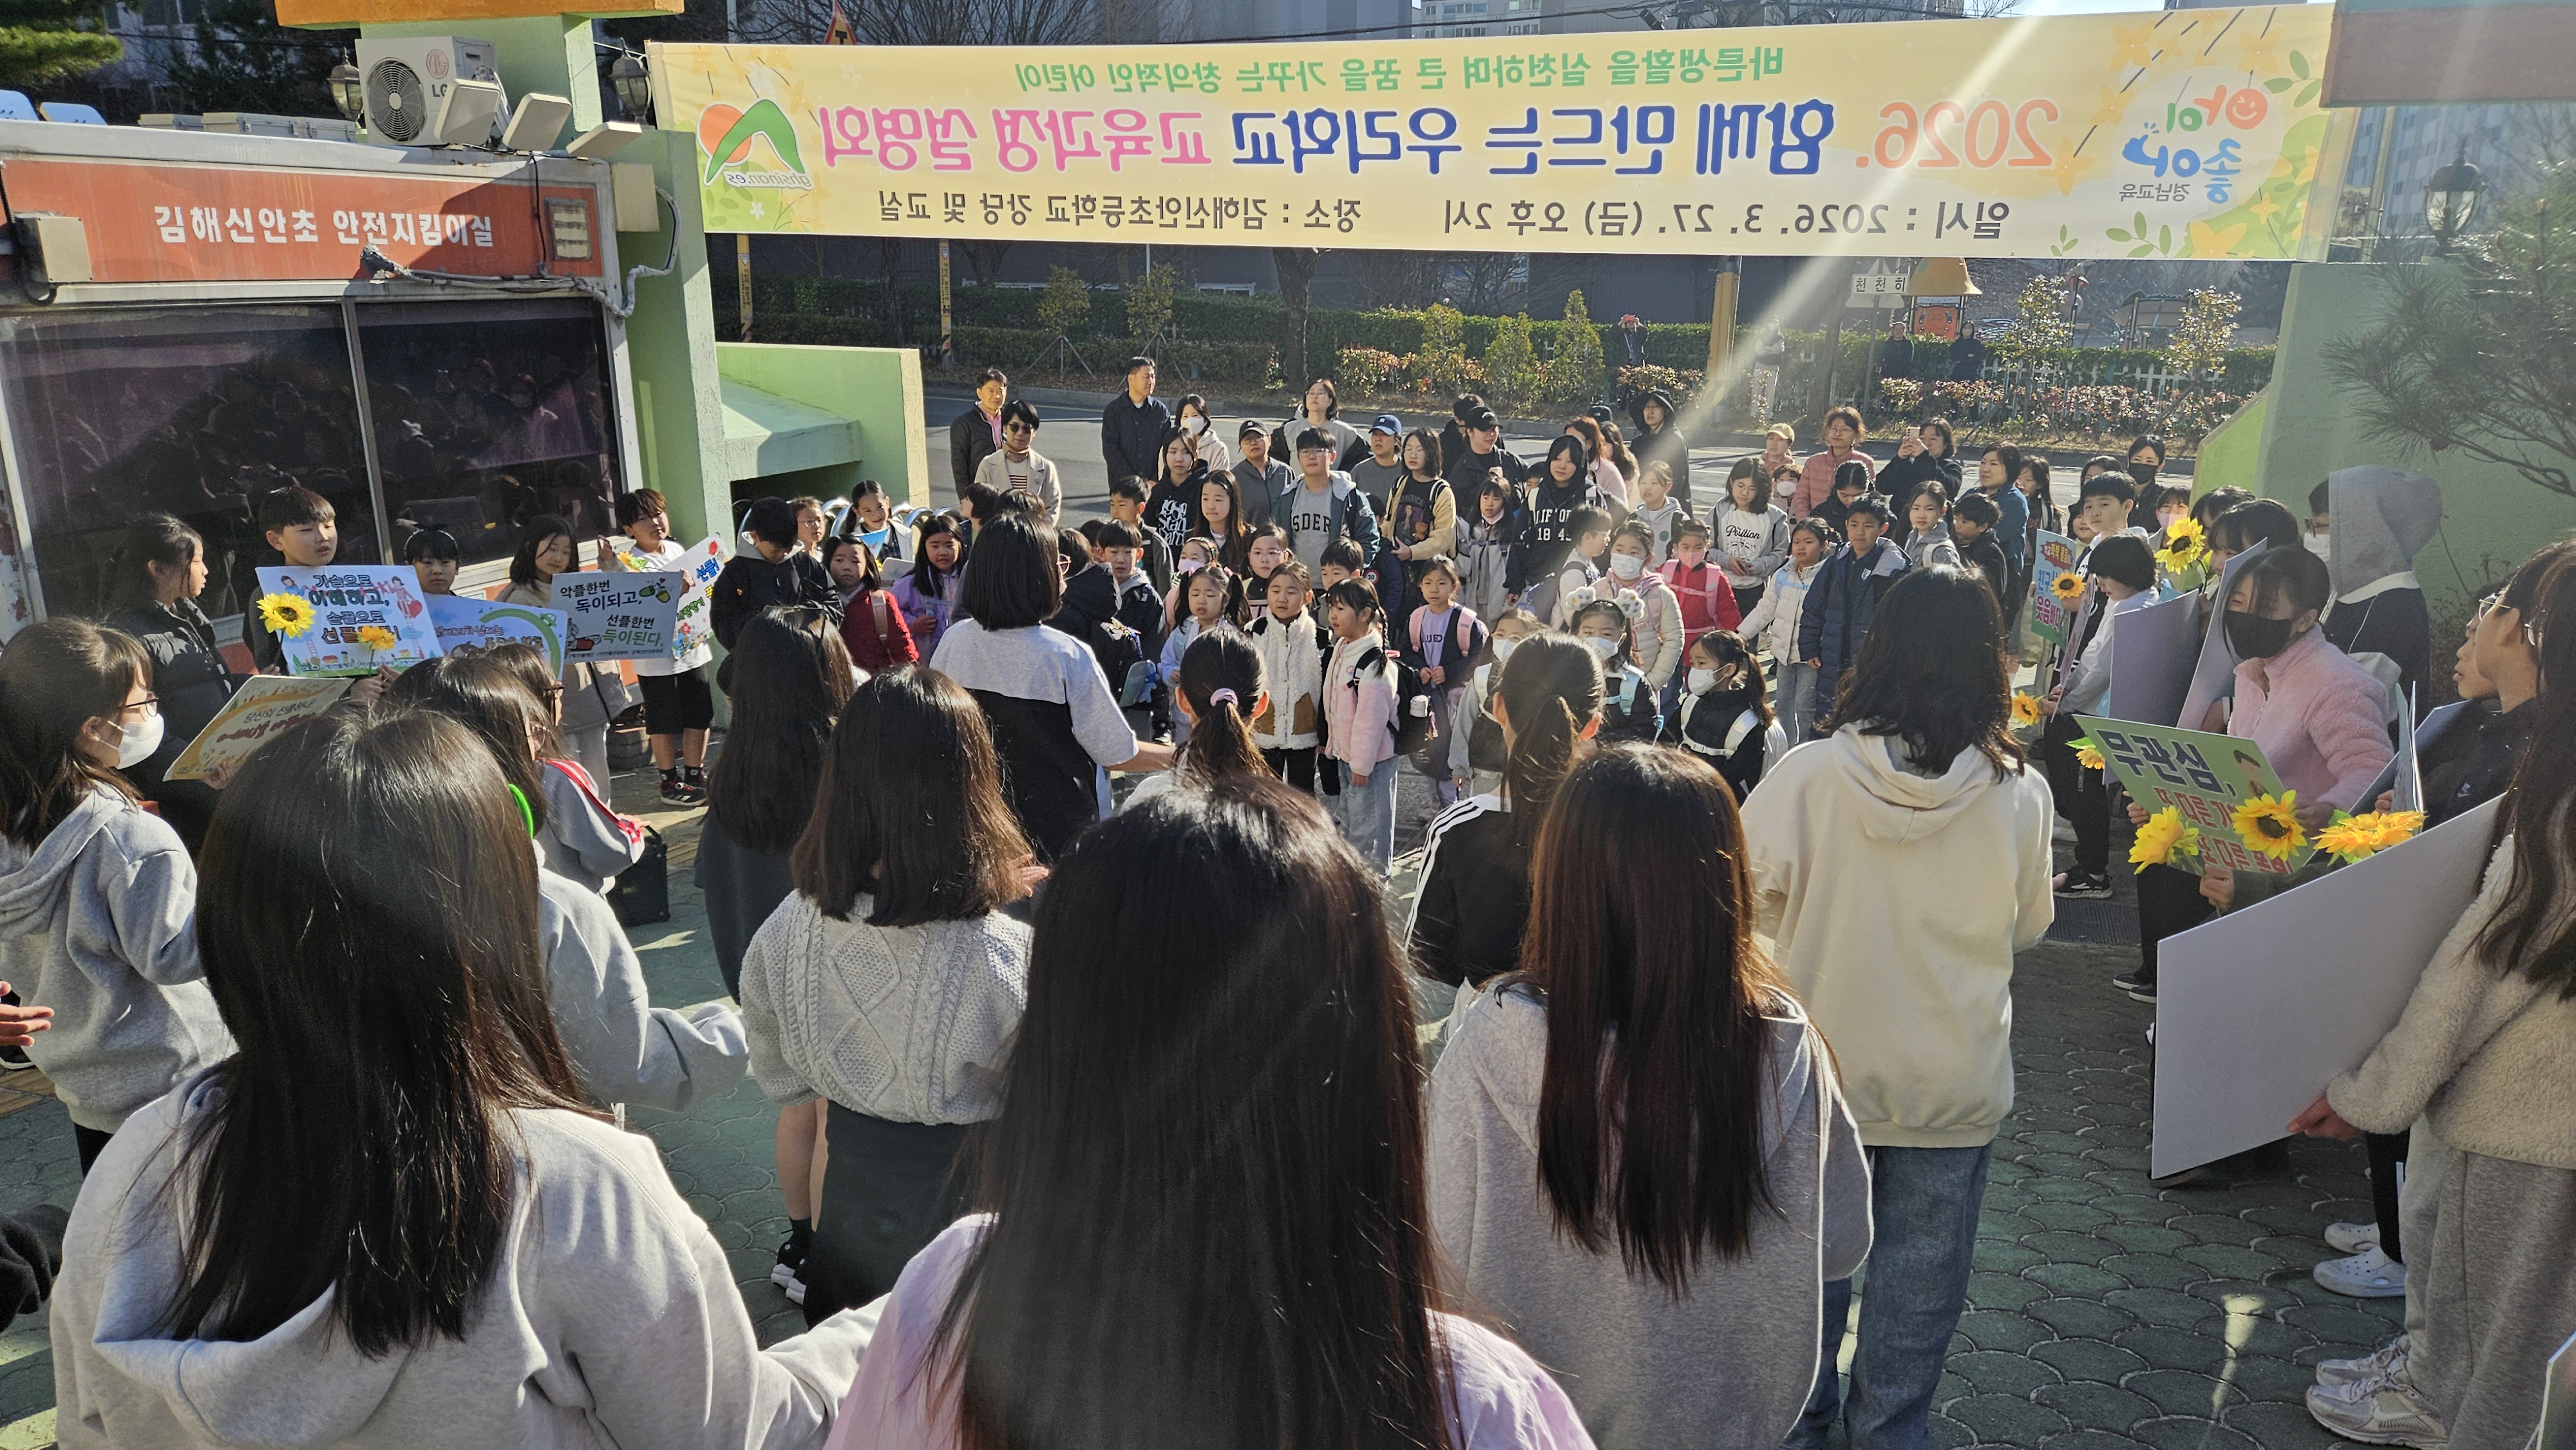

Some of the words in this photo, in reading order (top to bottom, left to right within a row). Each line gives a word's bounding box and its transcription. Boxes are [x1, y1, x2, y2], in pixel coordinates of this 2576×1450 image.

[155, 206, 318, 243] 김해신안초
[332, 210, 493, 247] 안전지킴이실
[1726, 525, 1761, 540] Position
[313, 574, 374, 588] 가슴으로
[560, 579, 611, 598] 악플한번
[575, 591, 643, 614] 독이되고,
[607, 614, 656, 630] 선플한번
[2096, 730, 2237, 798] 무관심,
[2173, 791, 2218, 829] 다른
